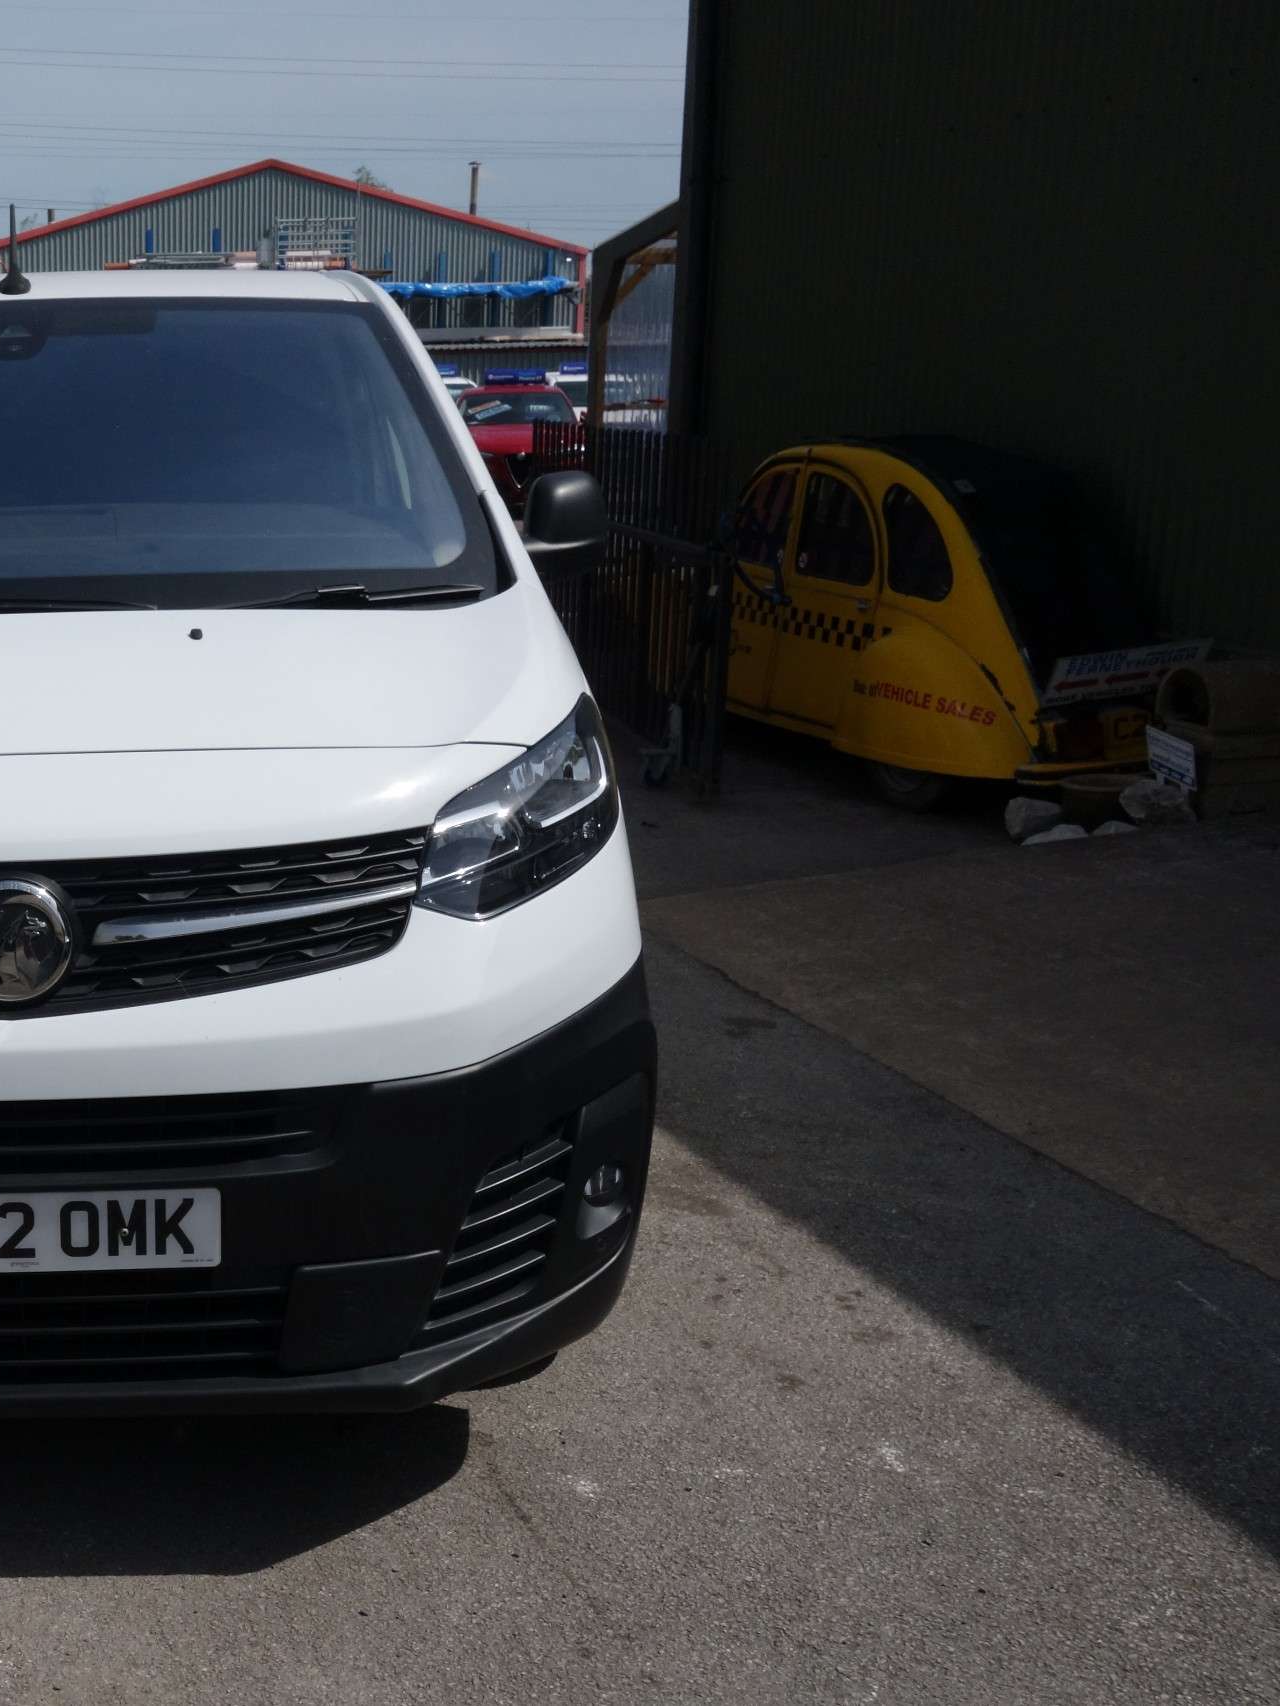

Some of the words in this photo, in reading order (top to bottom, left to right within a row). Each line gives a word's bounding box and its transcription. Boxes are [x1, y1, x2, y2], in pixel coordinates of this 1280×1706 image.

[878, 680, 932, 709] VEHICLE
[936, 696, 998, 726] SALES
[59, 1198, 195, 1258] OMK
